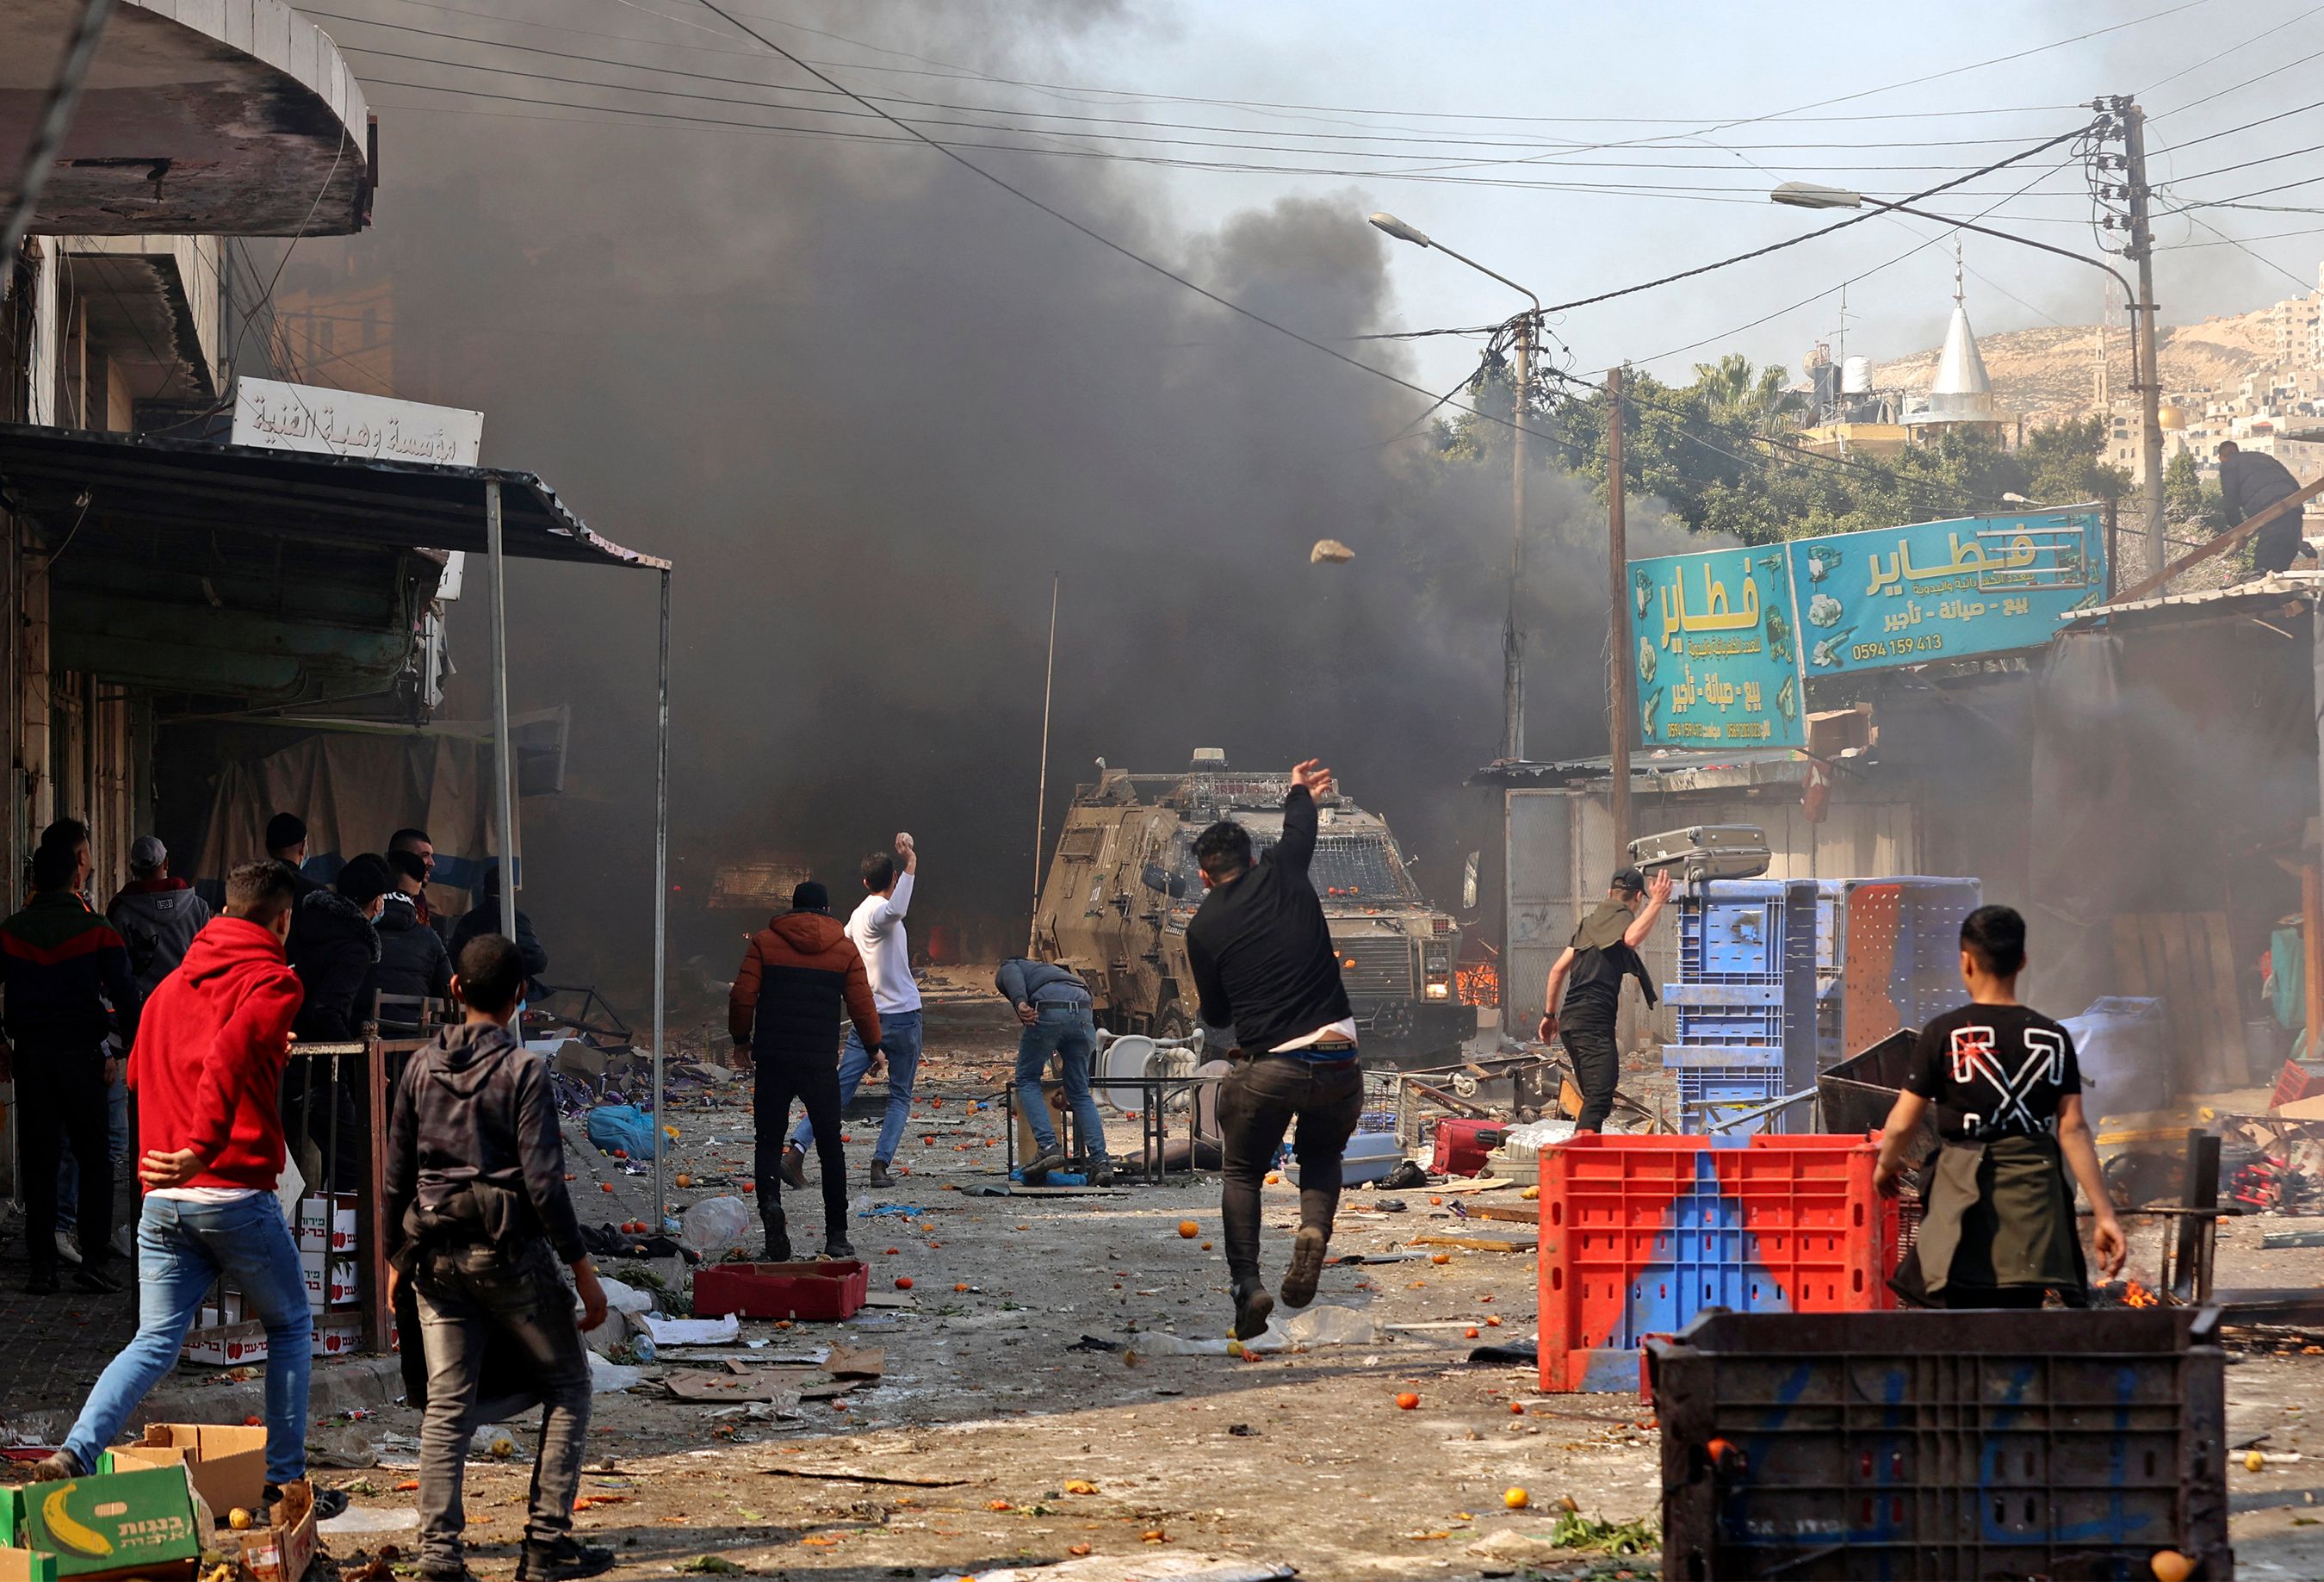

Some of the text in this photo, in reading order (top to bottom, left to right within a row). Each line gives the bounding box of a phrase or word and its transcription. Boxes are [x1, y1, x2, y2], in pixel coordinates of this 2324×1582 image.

[252, 394, 456, 465] مؤسسة وهبة الفنية
[1867, 523, 2036, 597] فطاير
[1660, 557, 1760, 655] فطاير
[1883, 600, 1922, 633] تأجير
[1939, 599, 1986, 622] صيانة
[2003, 597, 2030, 617] بيع
[1852, 634, 1943, 661] 0594 159 413
[1671, 662, 1695, 714] تأجير
[1704, 673, 1734, 713] صيانة
[1744, 681, 1763, 712] بيع
[158, 899, 173, 909] 1981
[118, 1516, 184, 1536] בננות
